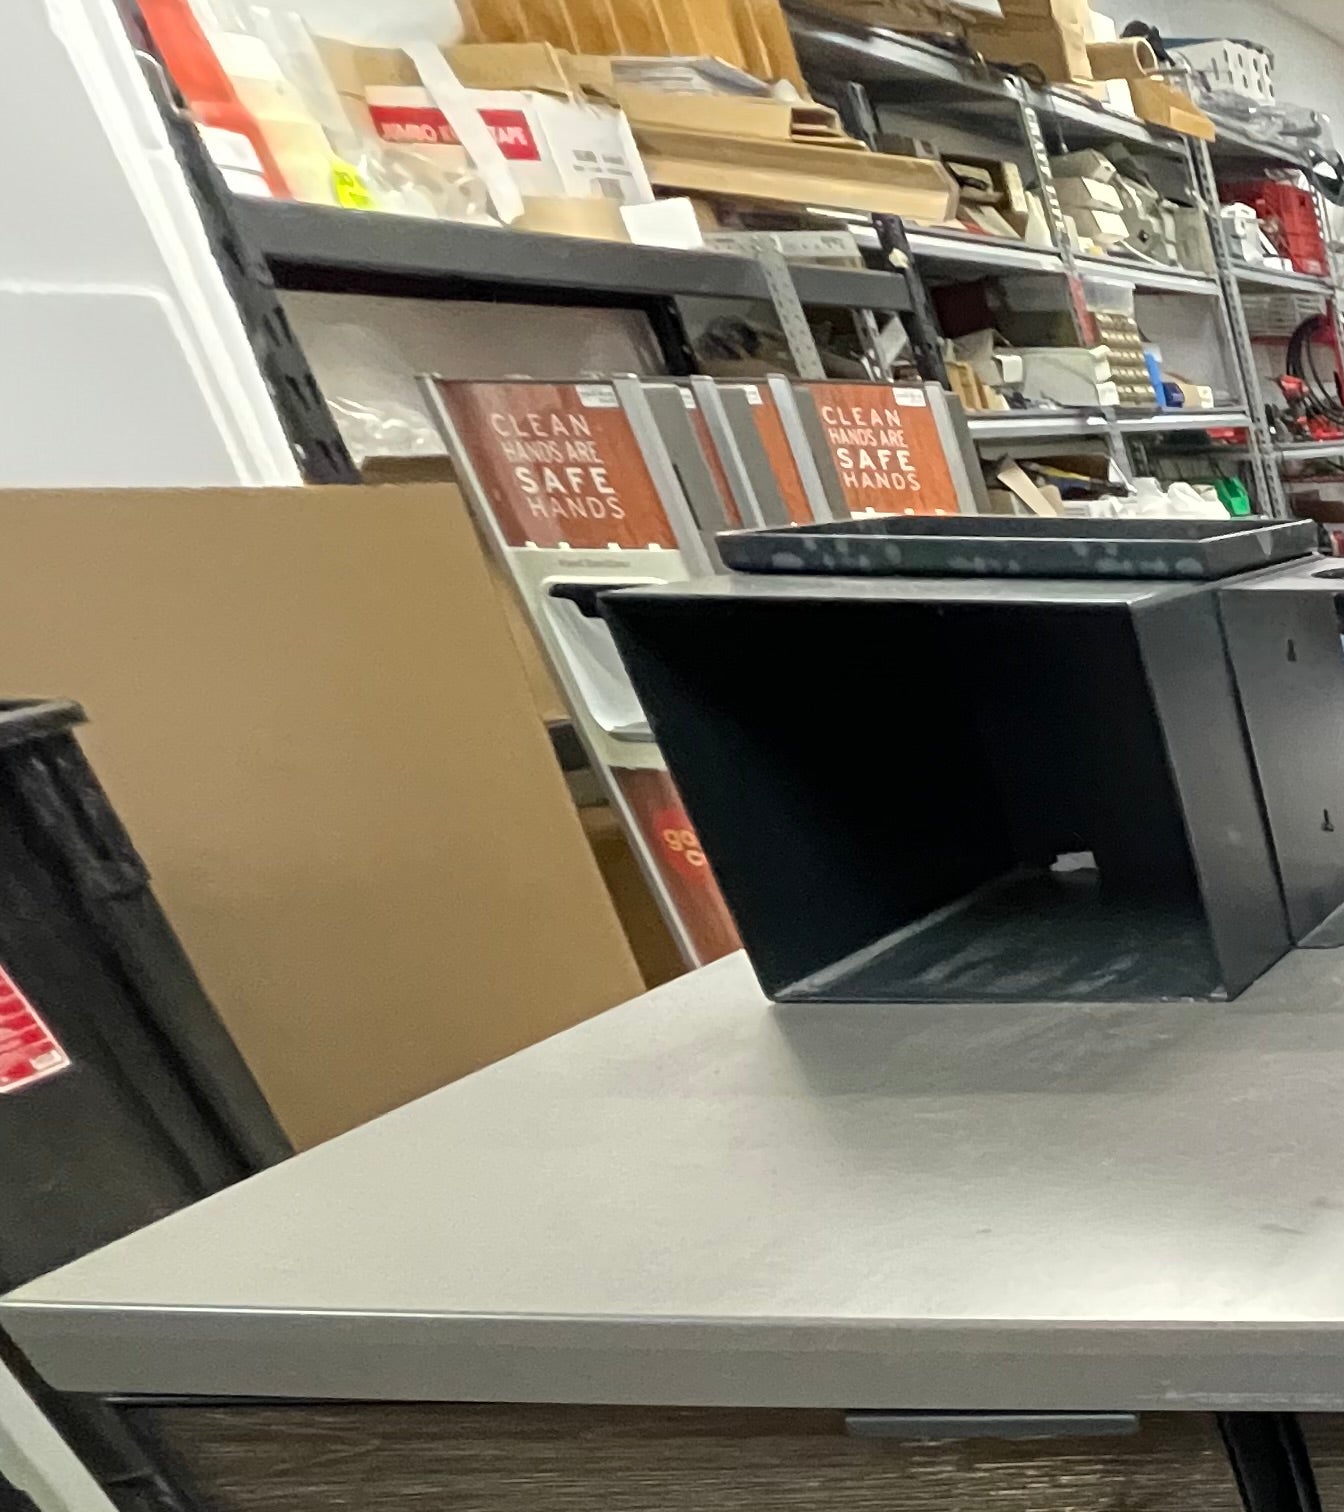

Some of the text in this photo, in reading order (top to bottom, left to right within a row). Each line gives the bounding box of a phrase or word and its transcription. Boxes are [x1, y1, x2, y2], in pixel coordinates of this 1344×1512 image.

[491, 413, 592, 438] CLEAN
[821, 406, 902, 427] CLEAN
[828, 428, 909, 448] HANDS ARE
[501, 440, 605, 464] HANDS ARE
[836, 447, 917, 472] SAFE
[515, 467, 616, 495] SAFE
[842, 471, 922, 492] HANDS
[525, 496, 626, 520] HANDS
